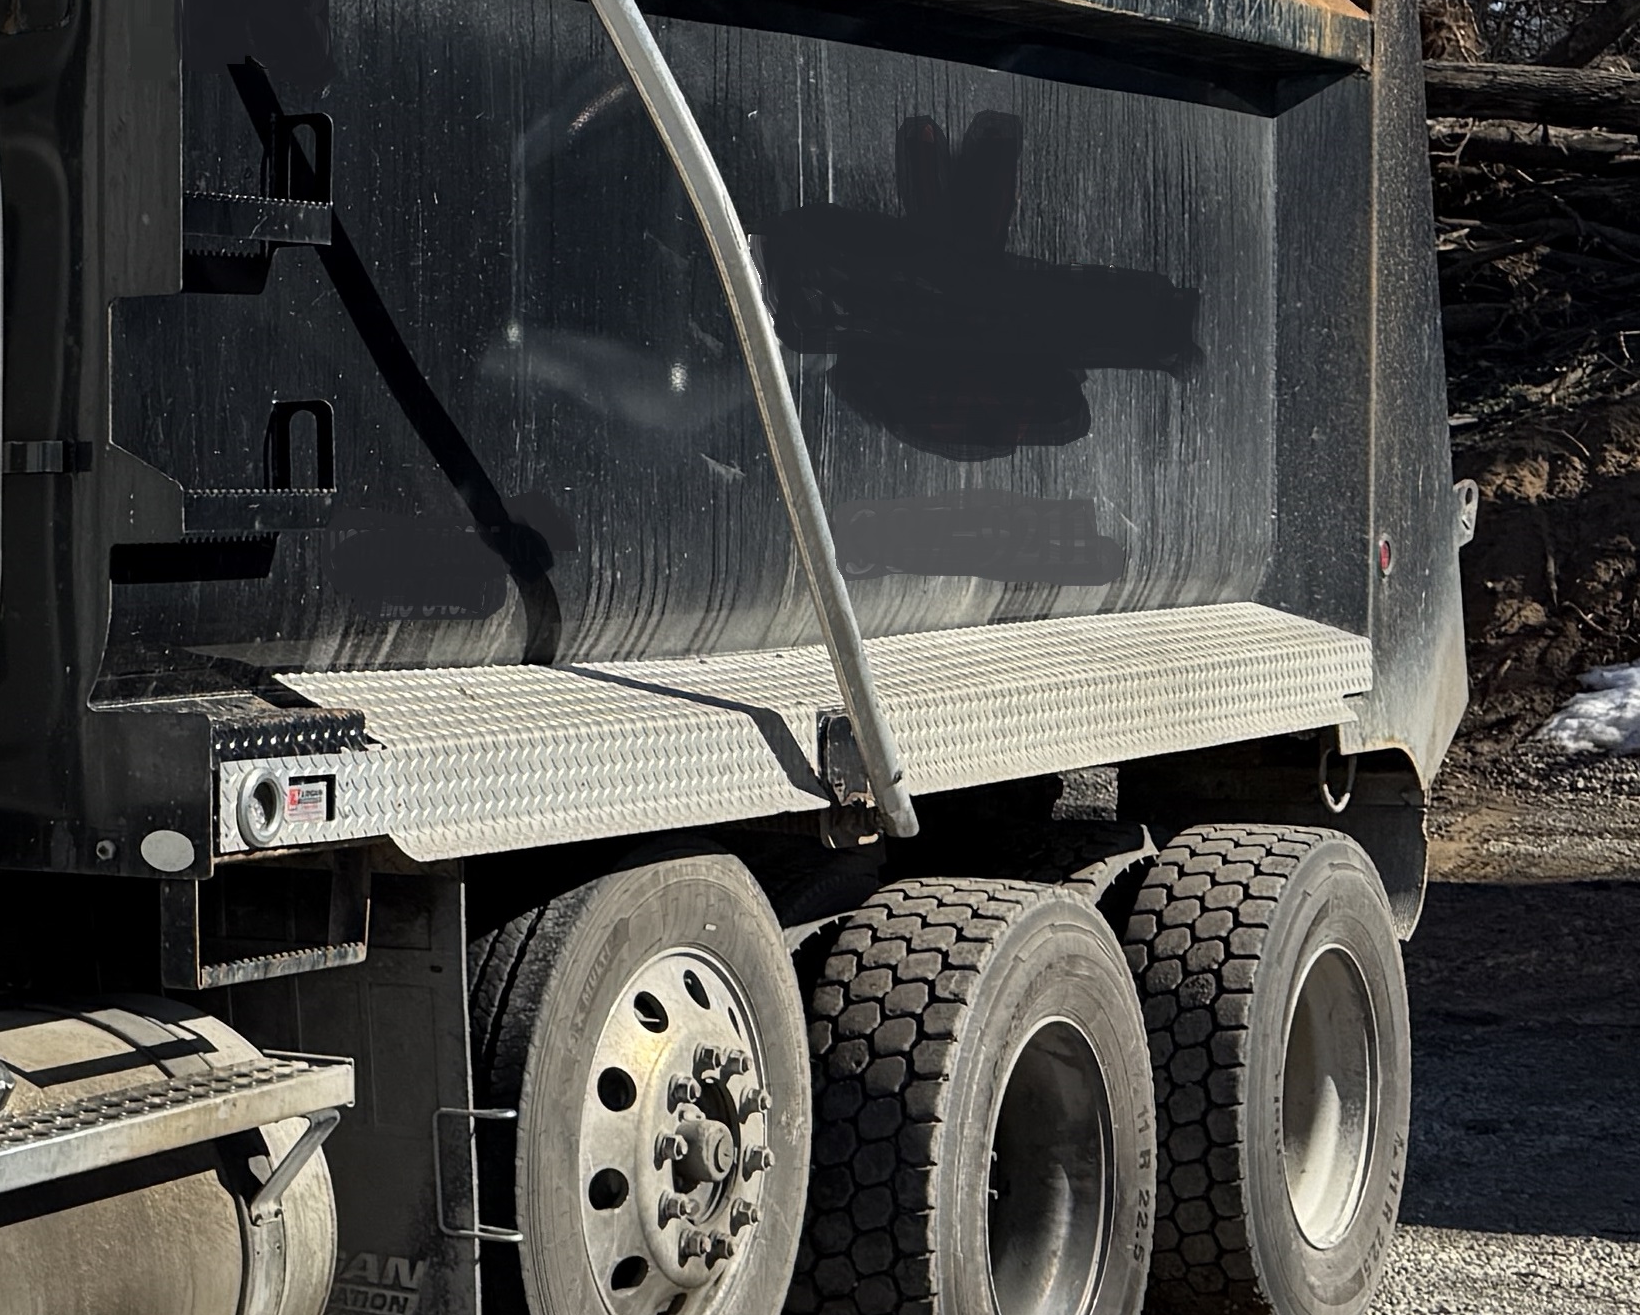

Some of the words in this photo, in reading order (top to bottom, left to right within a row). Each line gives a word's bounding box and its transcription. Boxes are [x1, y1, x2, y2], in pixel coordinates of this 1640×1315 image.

[1136, 1104, 1151, 1134] 11
[1138, 1149, 1152, 1171] R
[1132, 1188, 1152, 1264] 22.5
[1381, 1200, 1394, 1225] R
